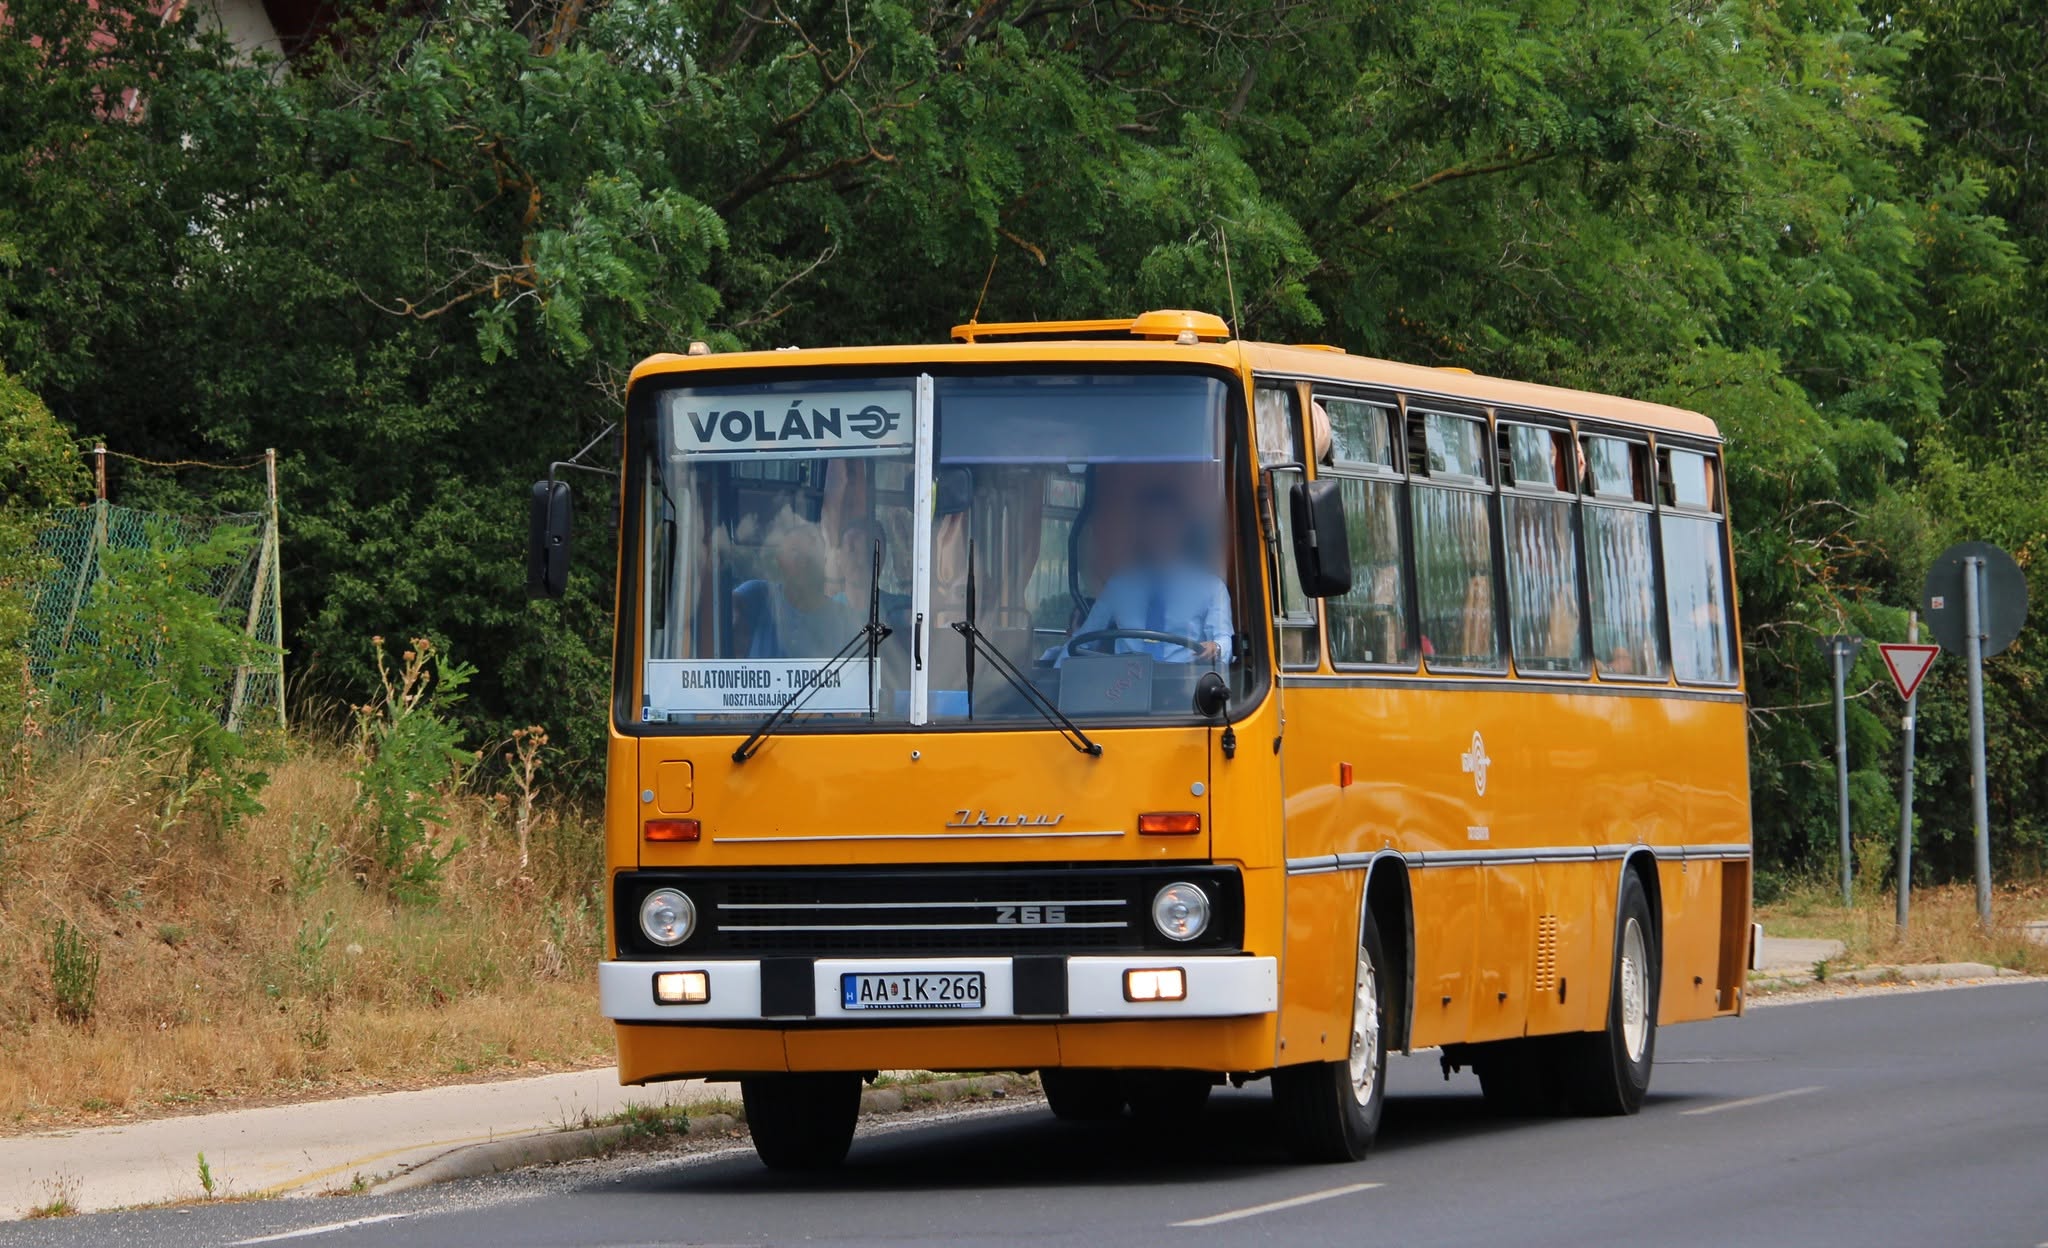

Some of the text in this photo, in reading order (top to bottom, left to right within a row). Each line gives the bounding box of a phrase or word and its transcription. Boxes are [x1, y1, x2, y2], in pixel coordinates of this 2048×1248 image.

[687, 400, 842, 443] VOLÁN
[682, 666, 771, 689] BALATONFÜRED
[786, 669, 841, 689] TAPOLCA
[723, 690, 797, 707] NOSZTALGIAJÁRAT
[946, 809, 1065, 827] Ikarus
[996, 906, 1066, 924] 266
